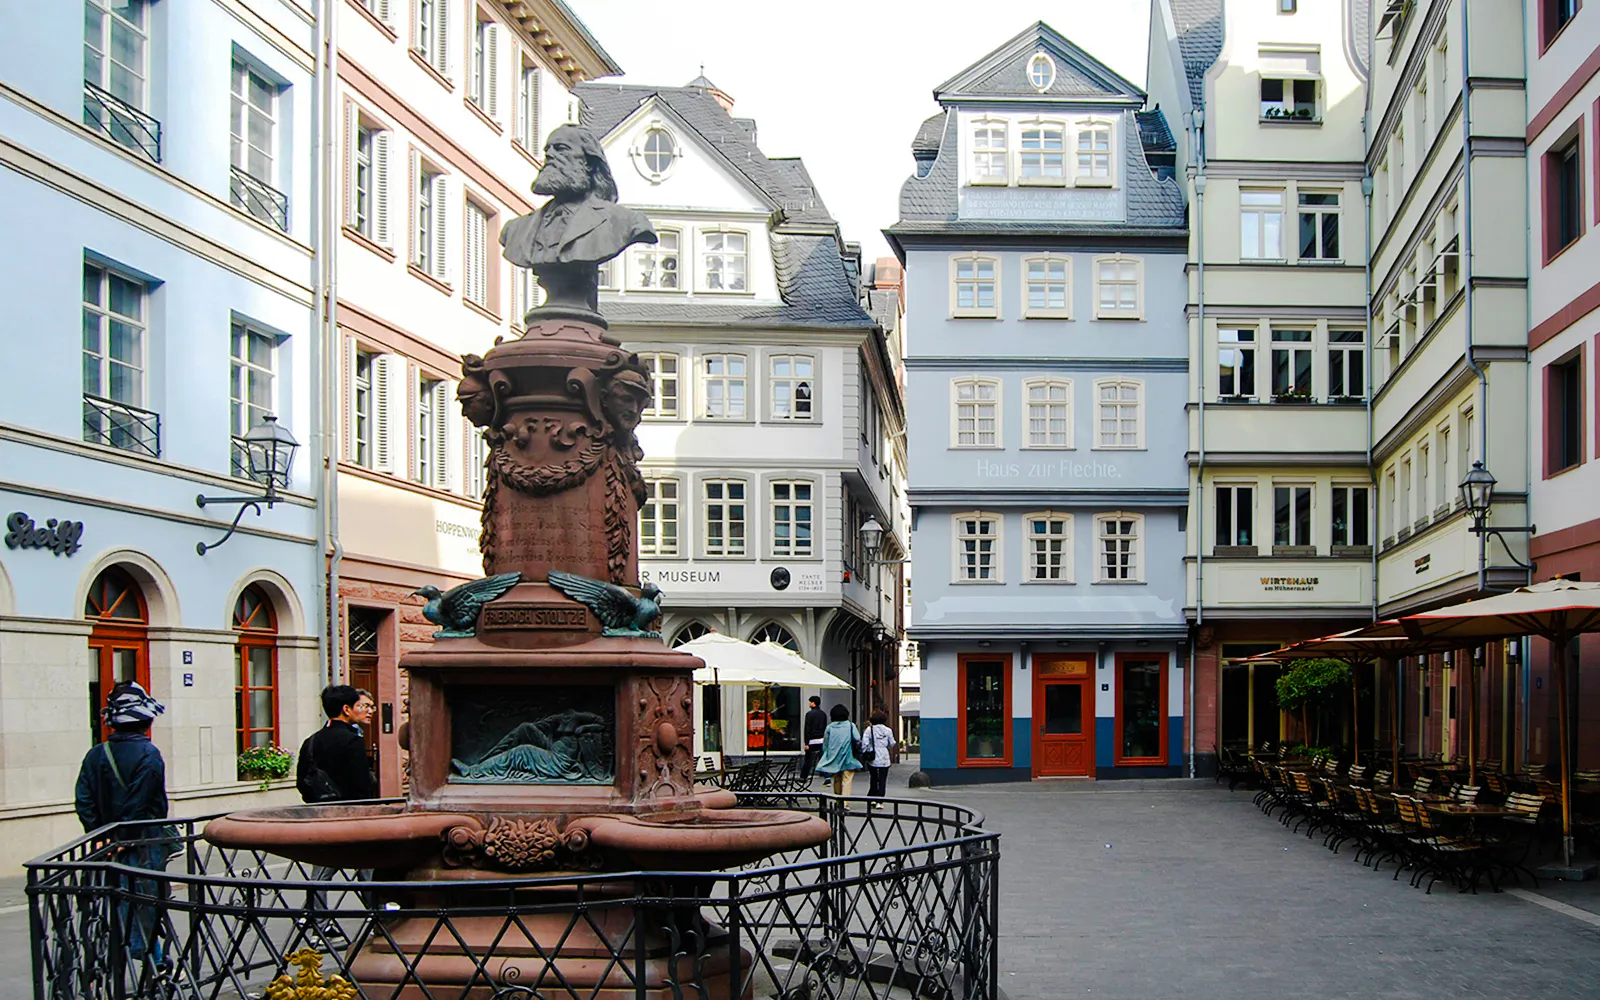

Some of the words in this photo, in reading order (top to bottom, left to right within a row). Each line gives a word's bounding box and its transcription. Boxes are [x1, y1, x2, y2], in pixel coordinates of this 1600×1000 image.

[977, 459, 1020, 478] Haus
[1028, 463, 1056, 478] zur
[5, 511, 83, 557] Steiff
[436, 519, 482, 540] HOPPENWO
[658, 571, 721, 583] MUSEUM
[1260, 577, 1319, 585] WIRTSHAUS
[485, 609, 533, 626] FRIEDRICH
[536, 609, 586, 626] STOLTZE
